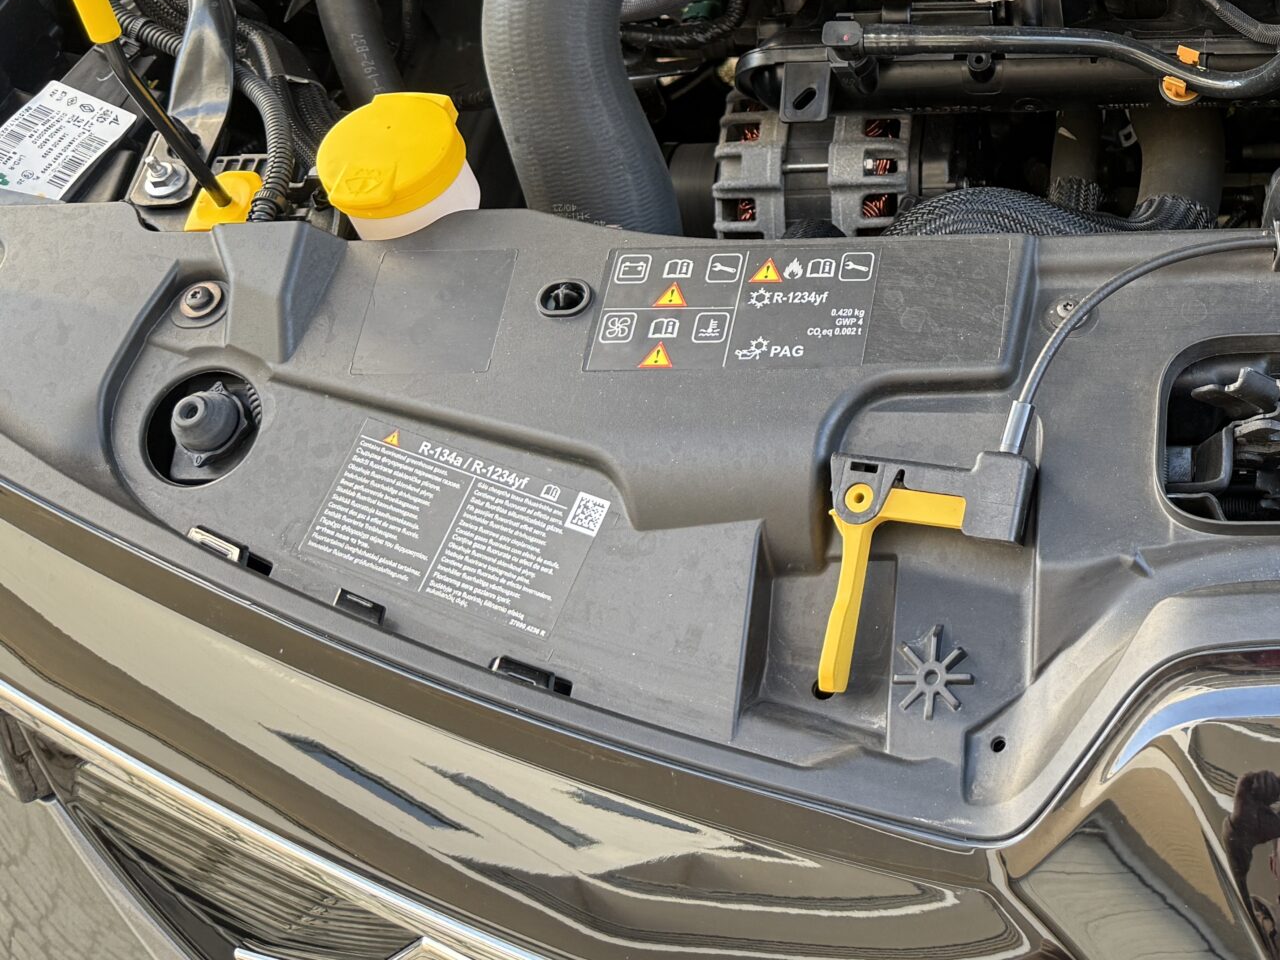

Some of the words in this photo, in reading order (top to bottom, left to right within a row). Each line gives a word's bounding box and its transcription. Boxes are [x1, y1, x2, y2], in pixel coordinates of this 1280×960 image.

[773, 292, 829, 305] R-1234yf
[831, 309, 852, 317] 0.420
[854, 309, 864, 317] kg
[835, 318, 856, 326] GWP
[770, 346, 804, 357] PAG
[418, 440, 464, 468] R-134a
[472, 461, 530, 489] R-1234yf
